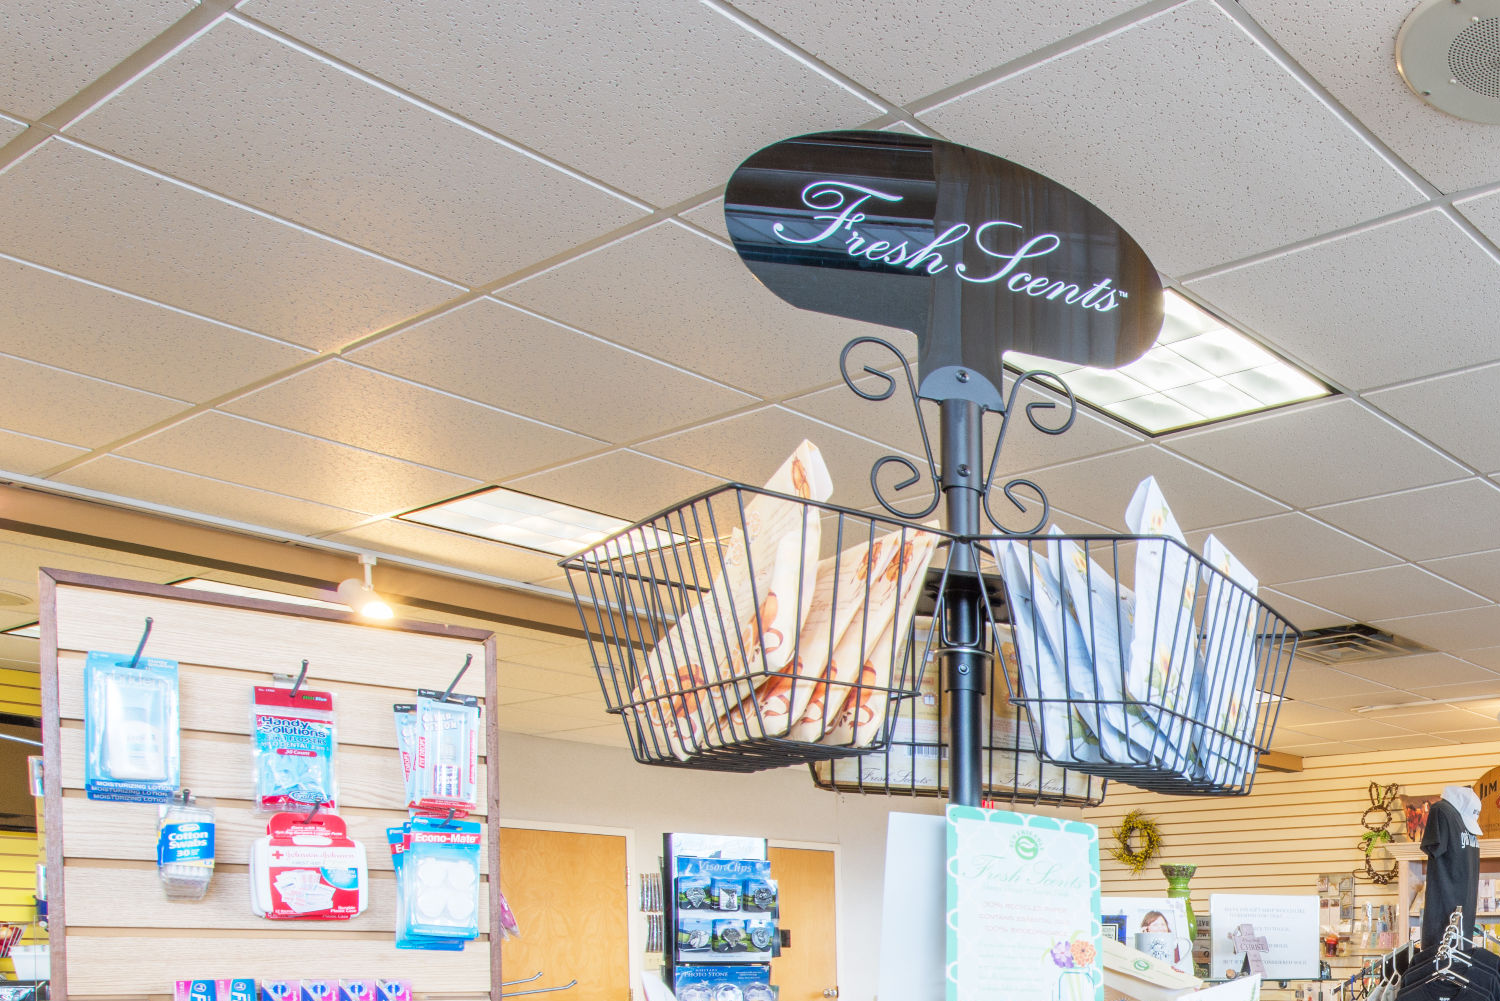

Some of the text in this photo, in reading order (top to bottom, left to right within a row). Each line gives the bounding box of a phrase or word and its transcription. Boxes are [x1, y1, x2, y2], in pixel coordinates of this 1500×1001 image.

[772, 181, 970, 275] Fresh
[262, 715, 310, 730] Handy
[262, 724, 327, 739] Solutions
[91, 785, 169, 797] MOISTURIZING LOTION
[95, 780, 175, 792] MOISTURIZING LOTION
[1480, 777, 1498, 801] JIM
[93, 792, 168, 804] MOISTURIZING LOTION
[168, 829, 209, 841] Cotton
[414, 831, 479, 844] Econo-Mate
[169, 838, 208, 850] Swabs
[176, 849, 191, 858] 30
[962, 854, 1023, 884] Fresh
